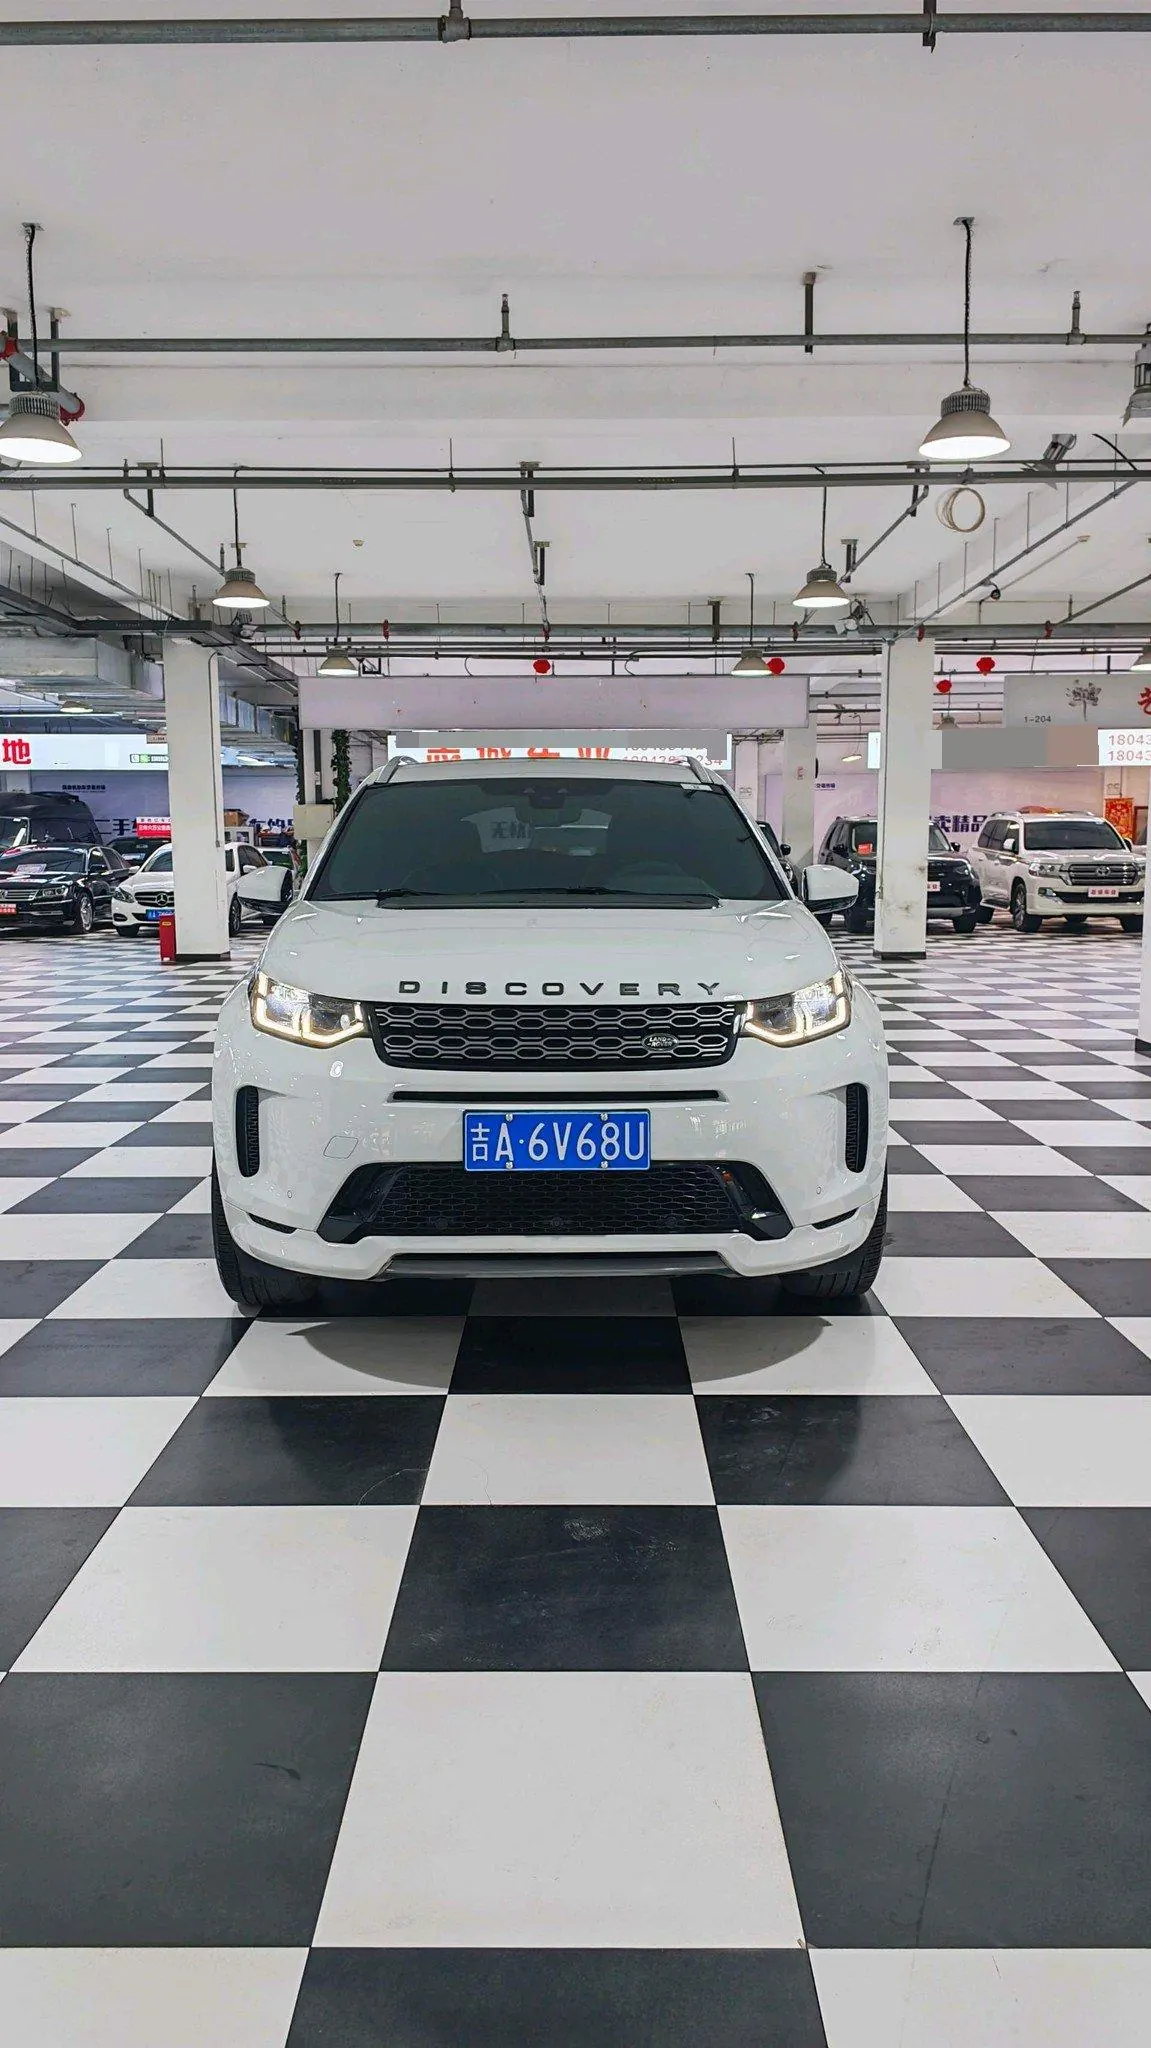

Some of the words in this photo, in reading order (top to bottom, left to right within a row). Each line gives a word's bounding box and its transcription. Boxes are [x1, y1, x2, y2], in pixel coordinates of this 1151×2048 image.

[1024, 715, 1051, 723] 1-204
[2, 738, 31, 764] 地
[94, 818, 136, 836] 二手
[932, 815, 988, 832] 卖精品
[399, 982, 720, 996] DISCOVERY
